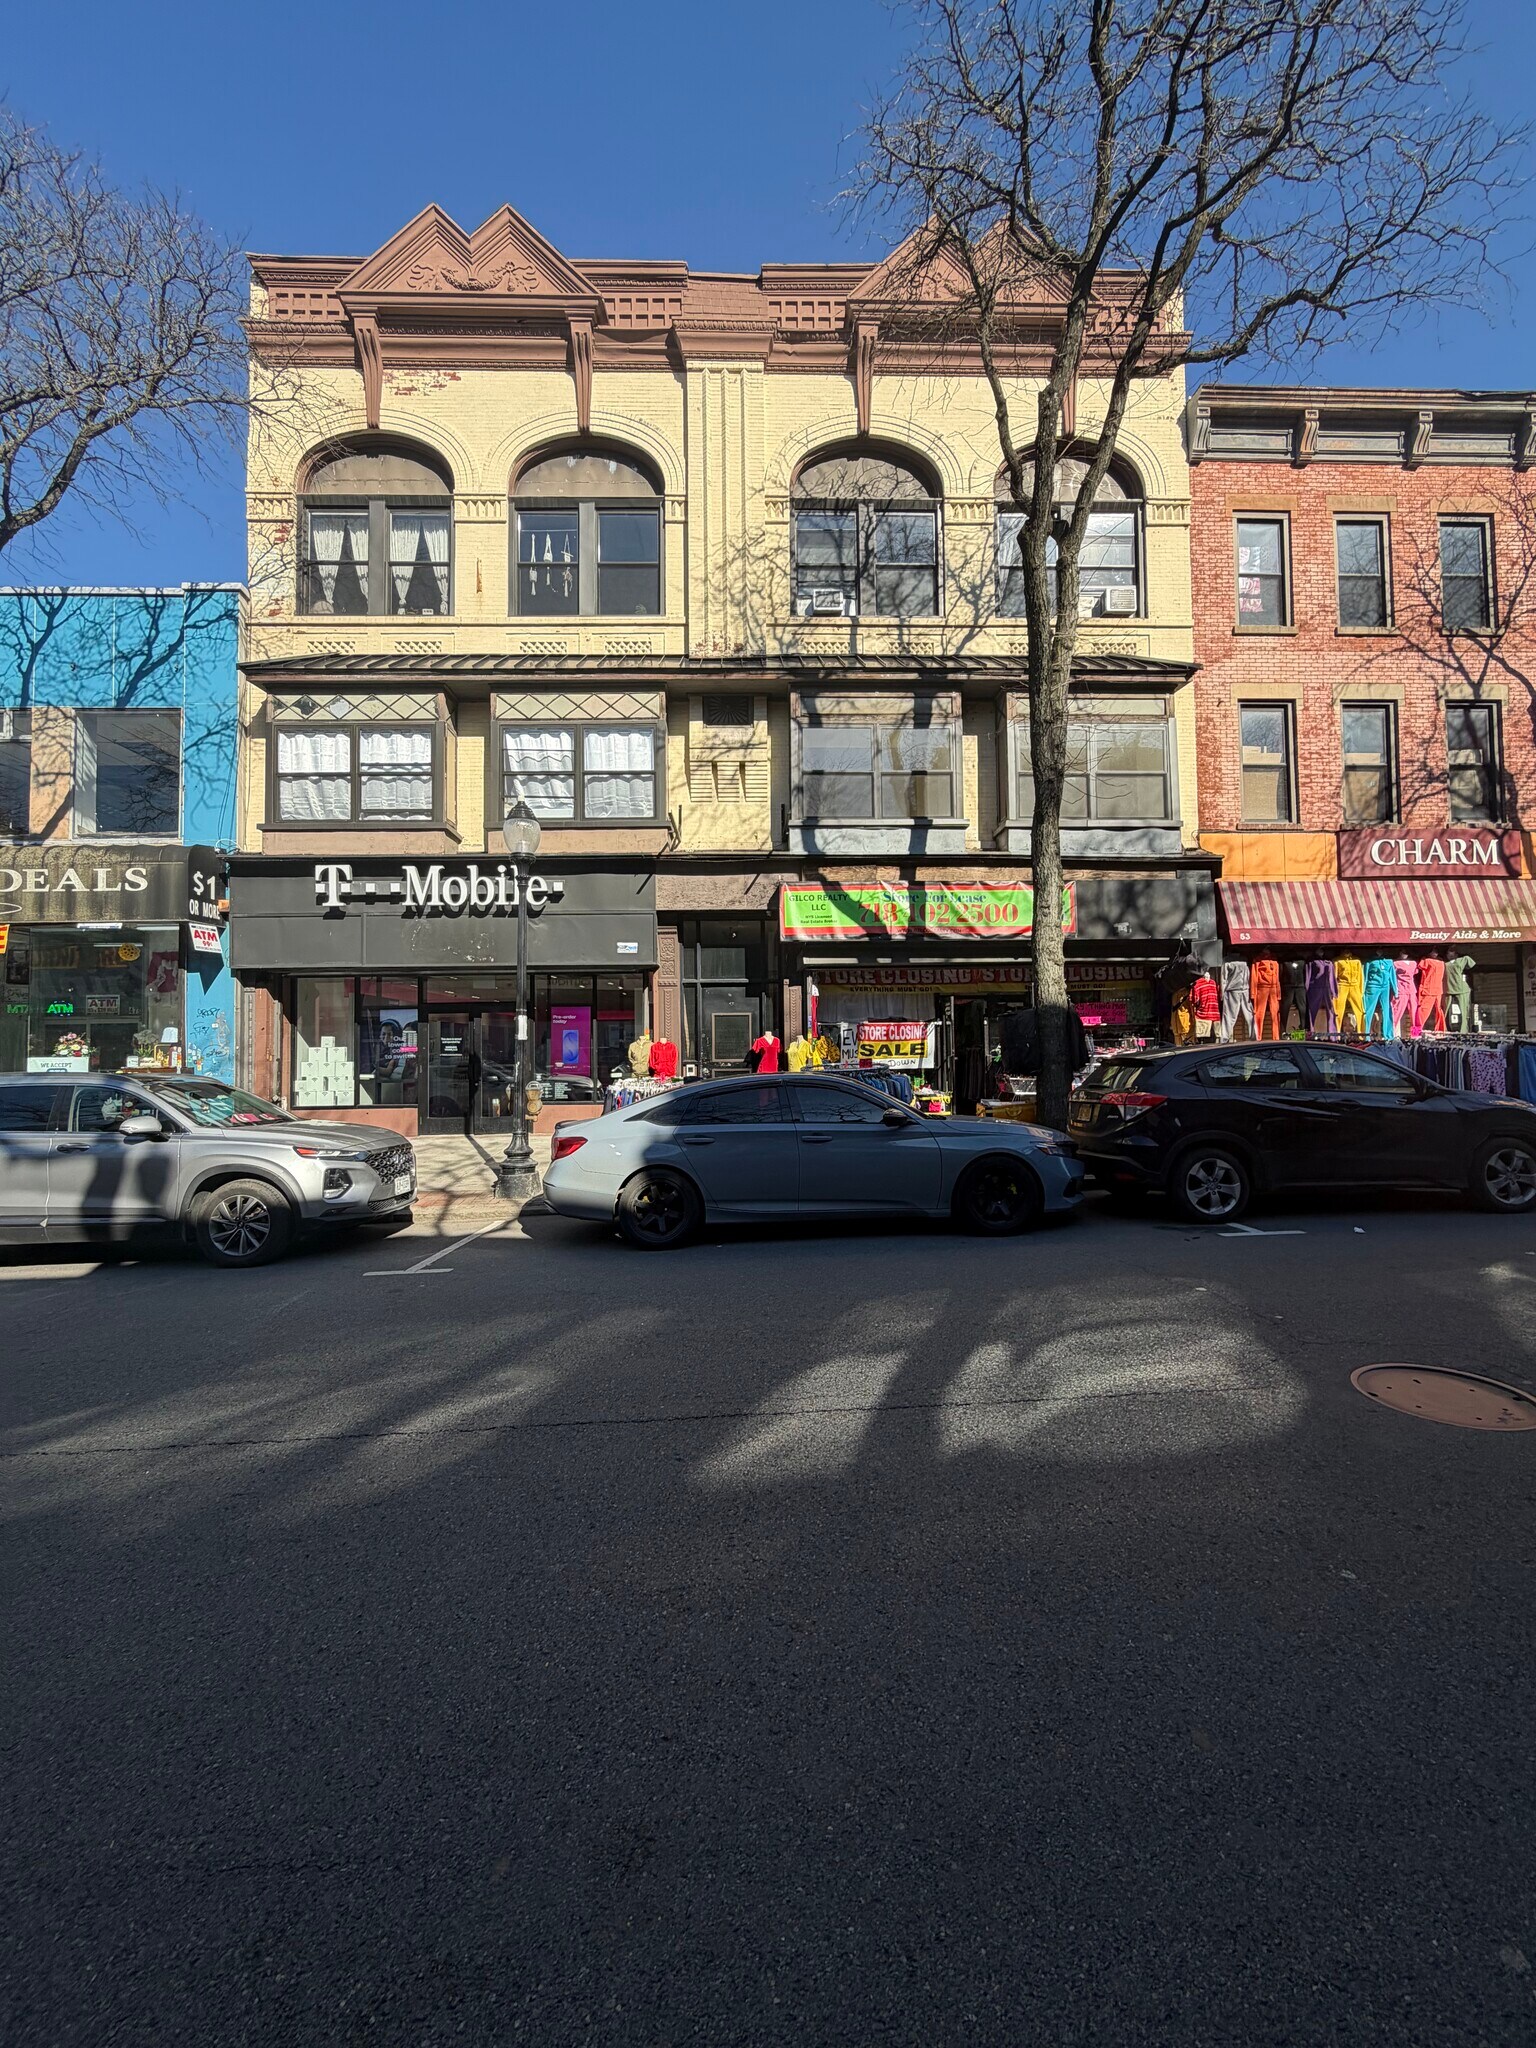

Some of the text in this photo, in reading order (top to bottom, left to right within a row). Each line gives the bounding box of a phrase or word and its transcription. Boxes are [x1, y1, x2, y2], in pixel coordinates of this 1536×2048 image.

[1371, 838, 1500, 866] CHARM
[0, 867, 148, 892] DEALS
[193, 871, 216, 900] $1
[789, 893, 848, 902] GILCO REALTY
[189, 899, 199, 916] OR
[811, 903, 826, 911] LLC
[858, 902, 898, 923] 718
[957, 902, 1018, 923] 2500
[194, 929, 218, 942] ATM
[1410, 930, 1521, 941] Beauty Aids & More
[880, 968, 971, 984] CLOSING
[983, 968, 1033, 982] STOR
[1067, 966, 1145, 982] LOSING
[47, 1003, 74, 1014] ATM
[860, 1025, 925, 1041] STORE CLOSING
[860, 1043, 925, 1057] SALE
